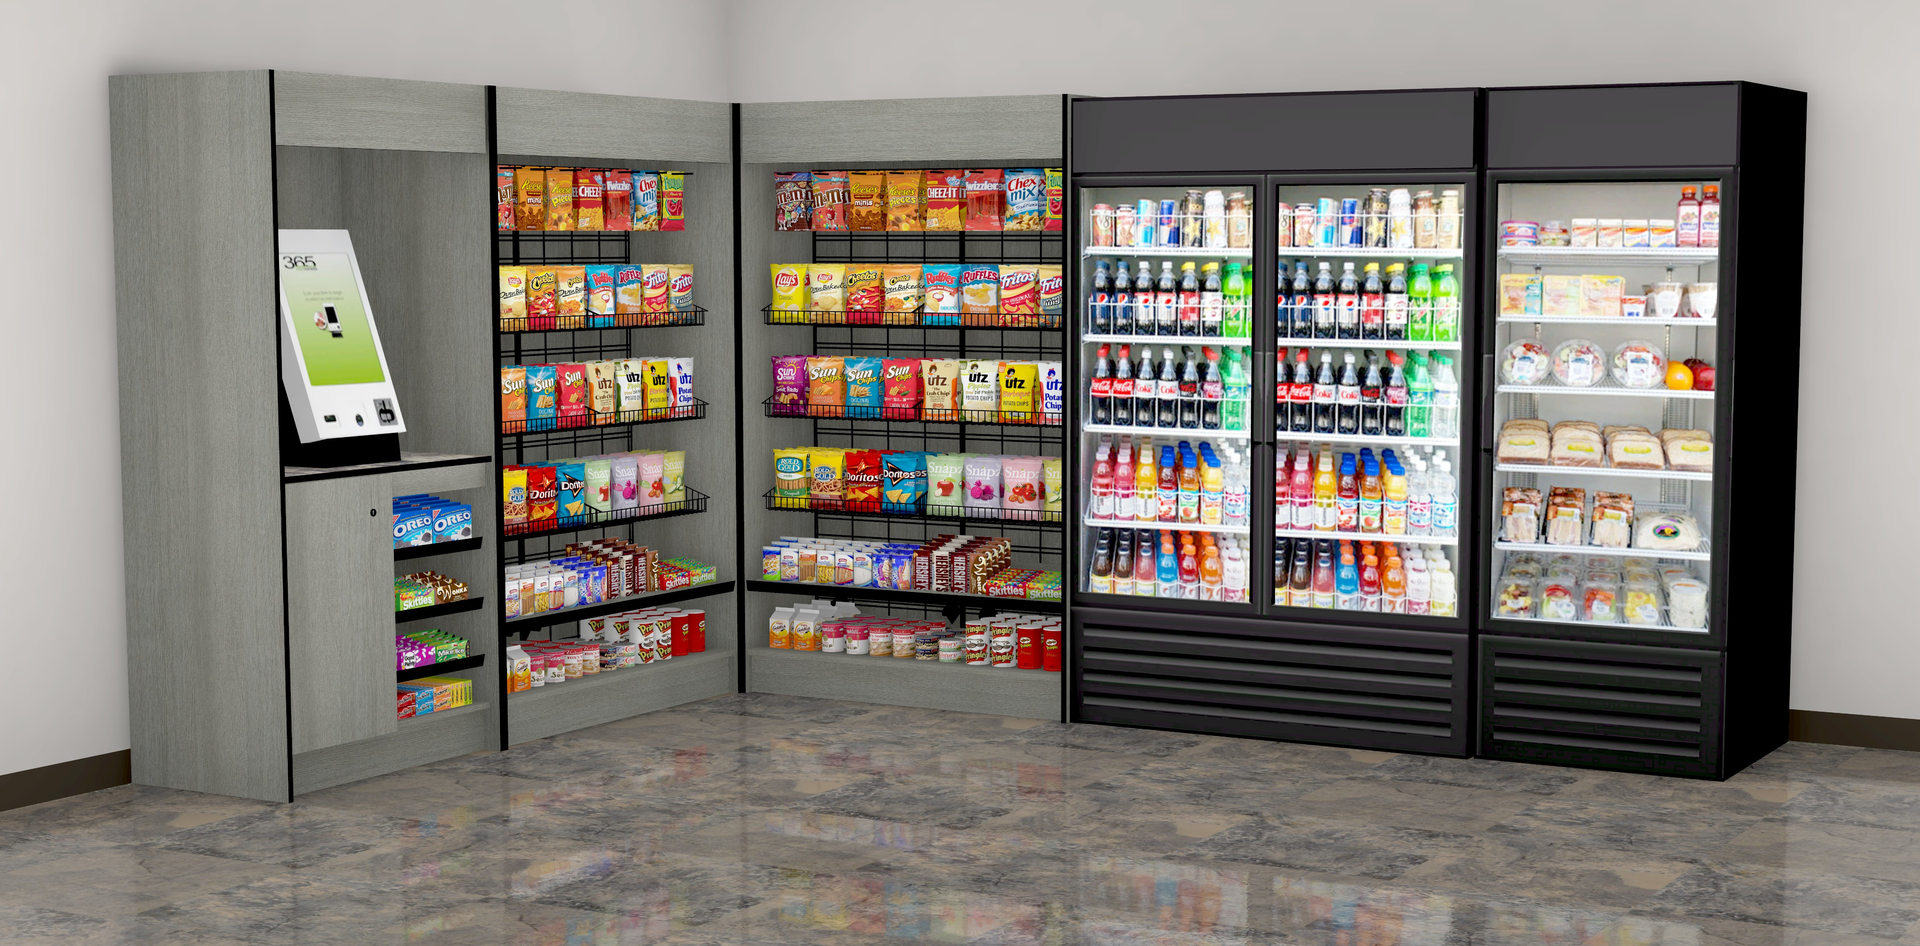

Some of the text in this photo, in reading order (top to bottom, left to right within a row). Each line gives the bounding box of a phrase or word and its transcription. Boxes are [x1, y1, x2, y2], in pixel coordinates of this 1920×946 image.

[1008, 177, 1037, 191] Chex
[1011, 186, 1036, 202] mix
[283, 256, 316, 269] 365
[810, 367, 837, 381] Sun
[848, 369, 873, 382] Sun
[886, 366, 910, 379] Sun
[393, 517, 431, 538] OREO
[434, 512, 471, 532] OREO
[989, 585, 1024, 597] Skittles
